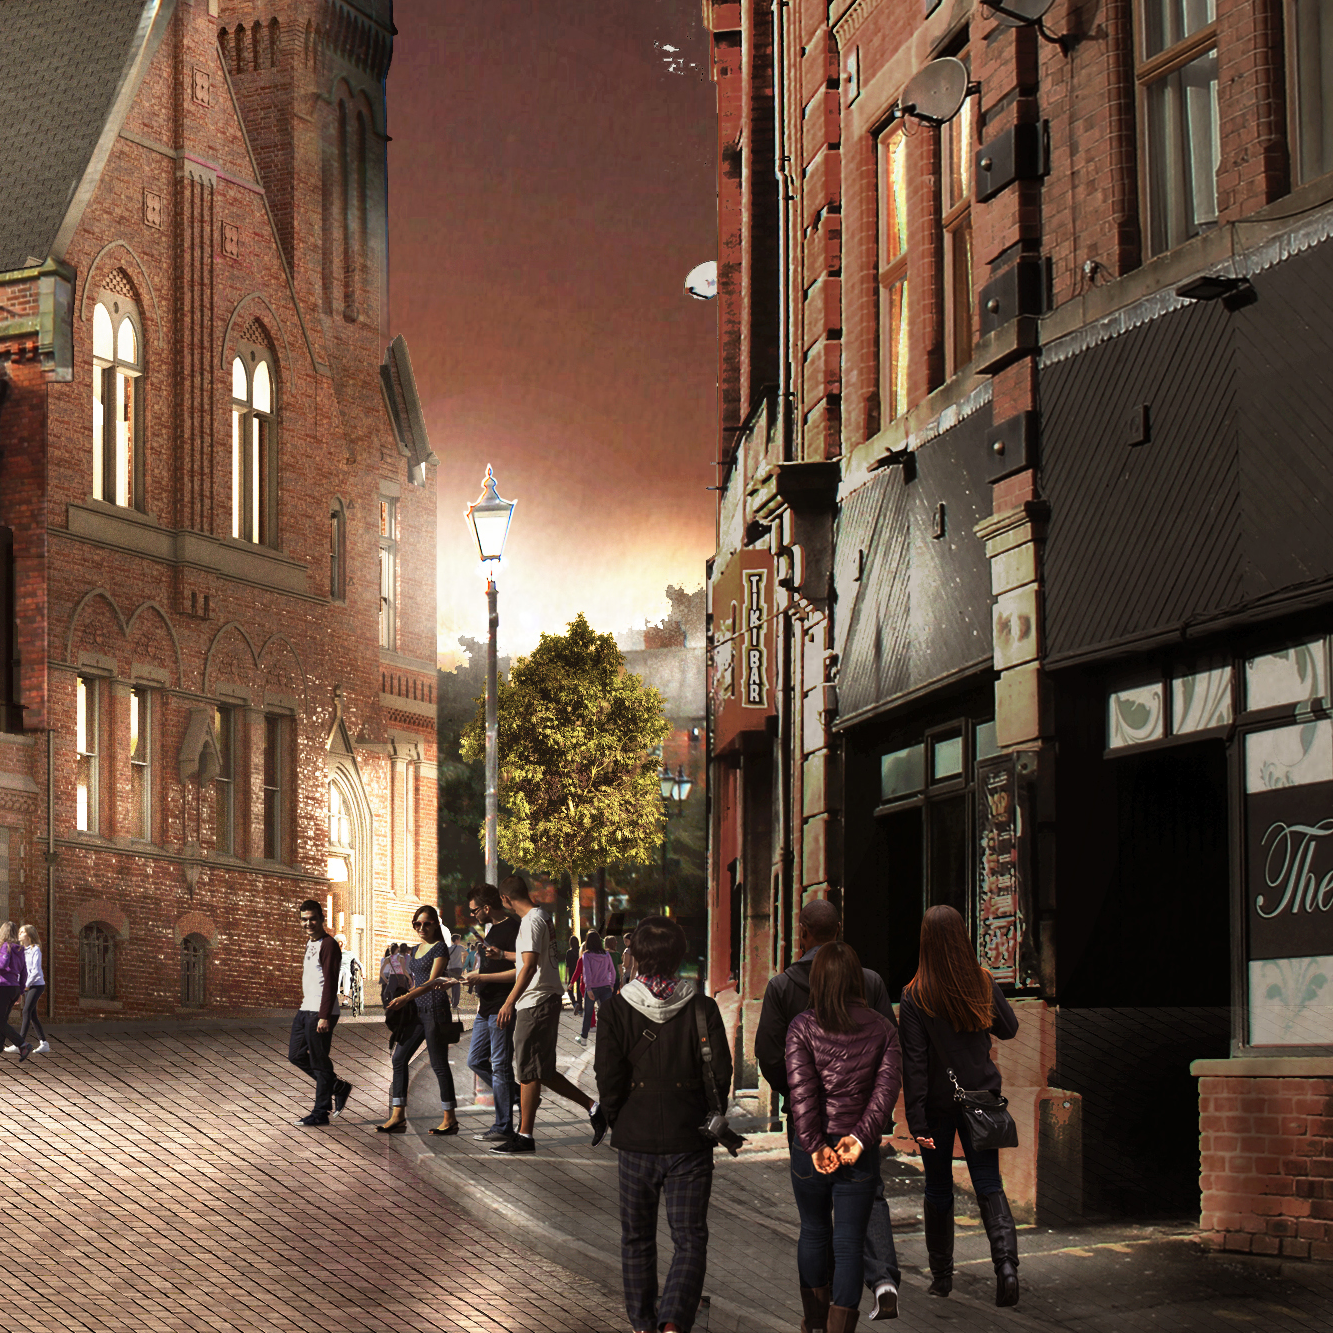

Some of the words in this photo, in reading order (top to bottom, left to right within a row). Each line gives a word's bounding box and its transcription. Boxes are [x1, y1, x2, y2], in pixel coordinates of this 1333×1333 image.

[749, 575, 762, 646] TIKI
[749, 650, 761, 702] BAR
[1256, 818, 1333, 919] The
